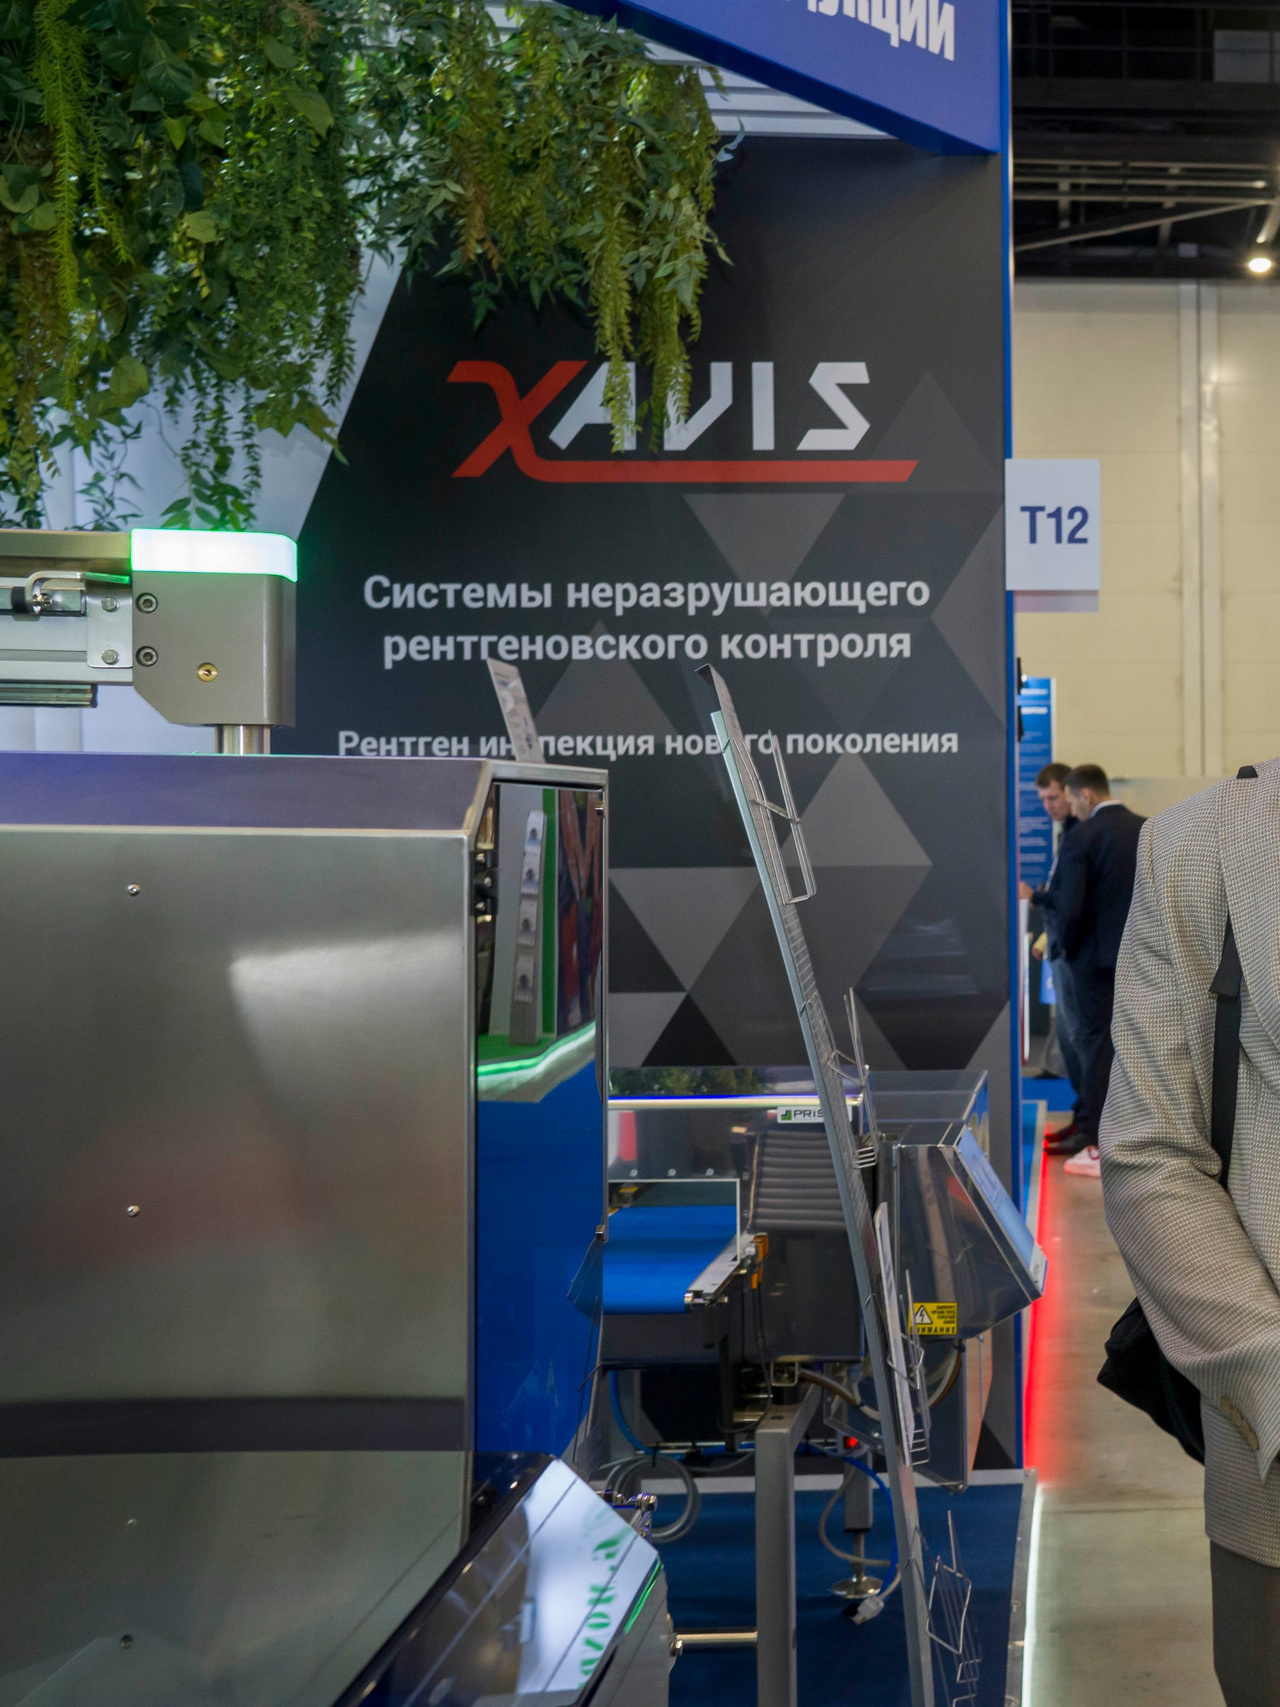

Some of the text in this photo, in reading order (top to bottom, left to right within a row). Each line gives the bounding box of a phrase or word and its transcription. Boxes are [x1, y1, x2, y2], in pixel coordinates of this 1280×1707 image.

[447, 361, 918, 483] XAVIS
[1020, 505, 1090, 545] T12
[364, 574, 931, 616] Системы неразрушающего
[384, 632, 911, 670] рентгеновского контроля
[338, 730, 959, 762] Рентген инпекция новго поколения
[910, 1326, 956, 1334] ИМАНИЕ
